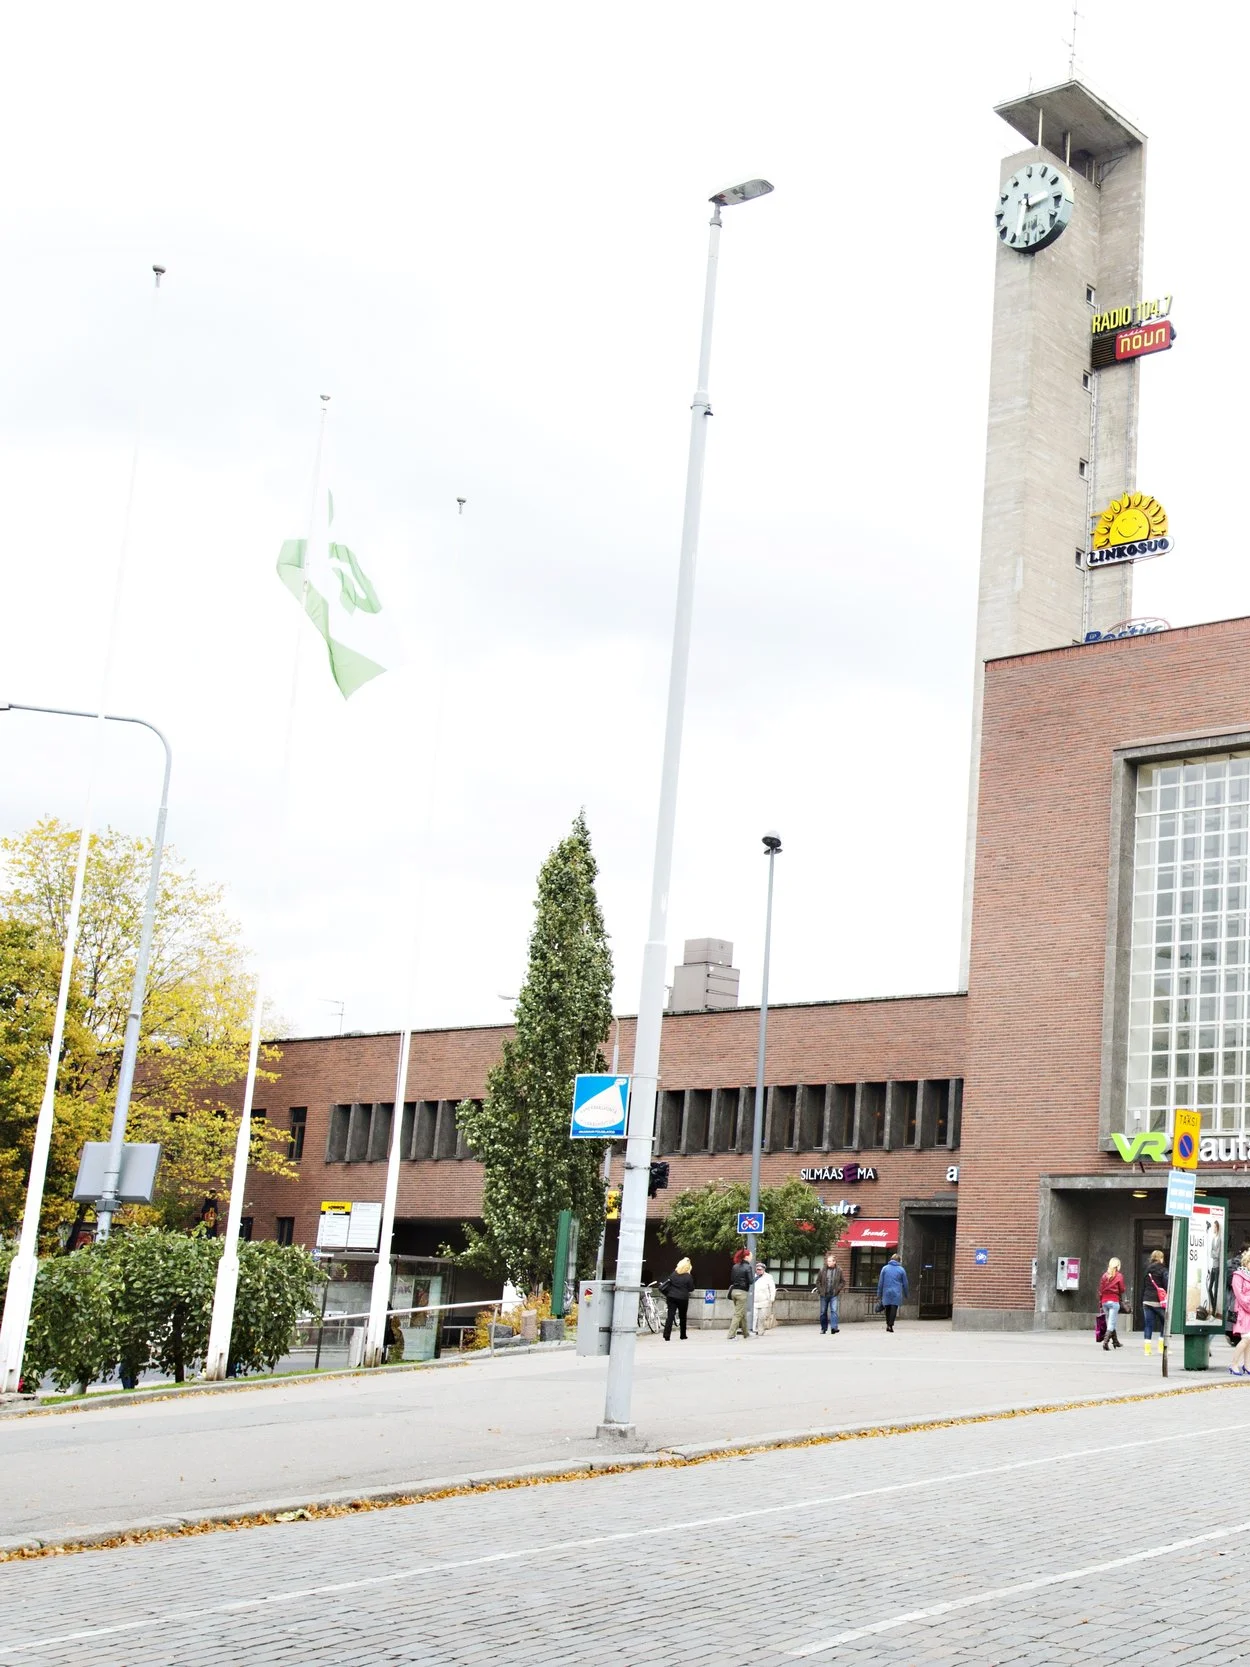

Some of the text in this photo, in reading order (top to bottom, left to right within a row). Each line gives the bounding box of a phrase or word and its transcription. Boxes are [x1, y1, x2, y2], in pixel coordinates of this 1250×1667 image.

[1092, 305, 1131, 334] RADIO
[1089, 538, 1170, 564] LINKOSUO
[1179, 1114, 1198, 1127] TAKSI
[1111, 1132, 1169, 1162] VR
[800, 1163, 876, 1183] SILMÄASEMA
[1190, 1235, 1204, 1247] Uusi
[1189, 1249, 1198, 1261] S8
